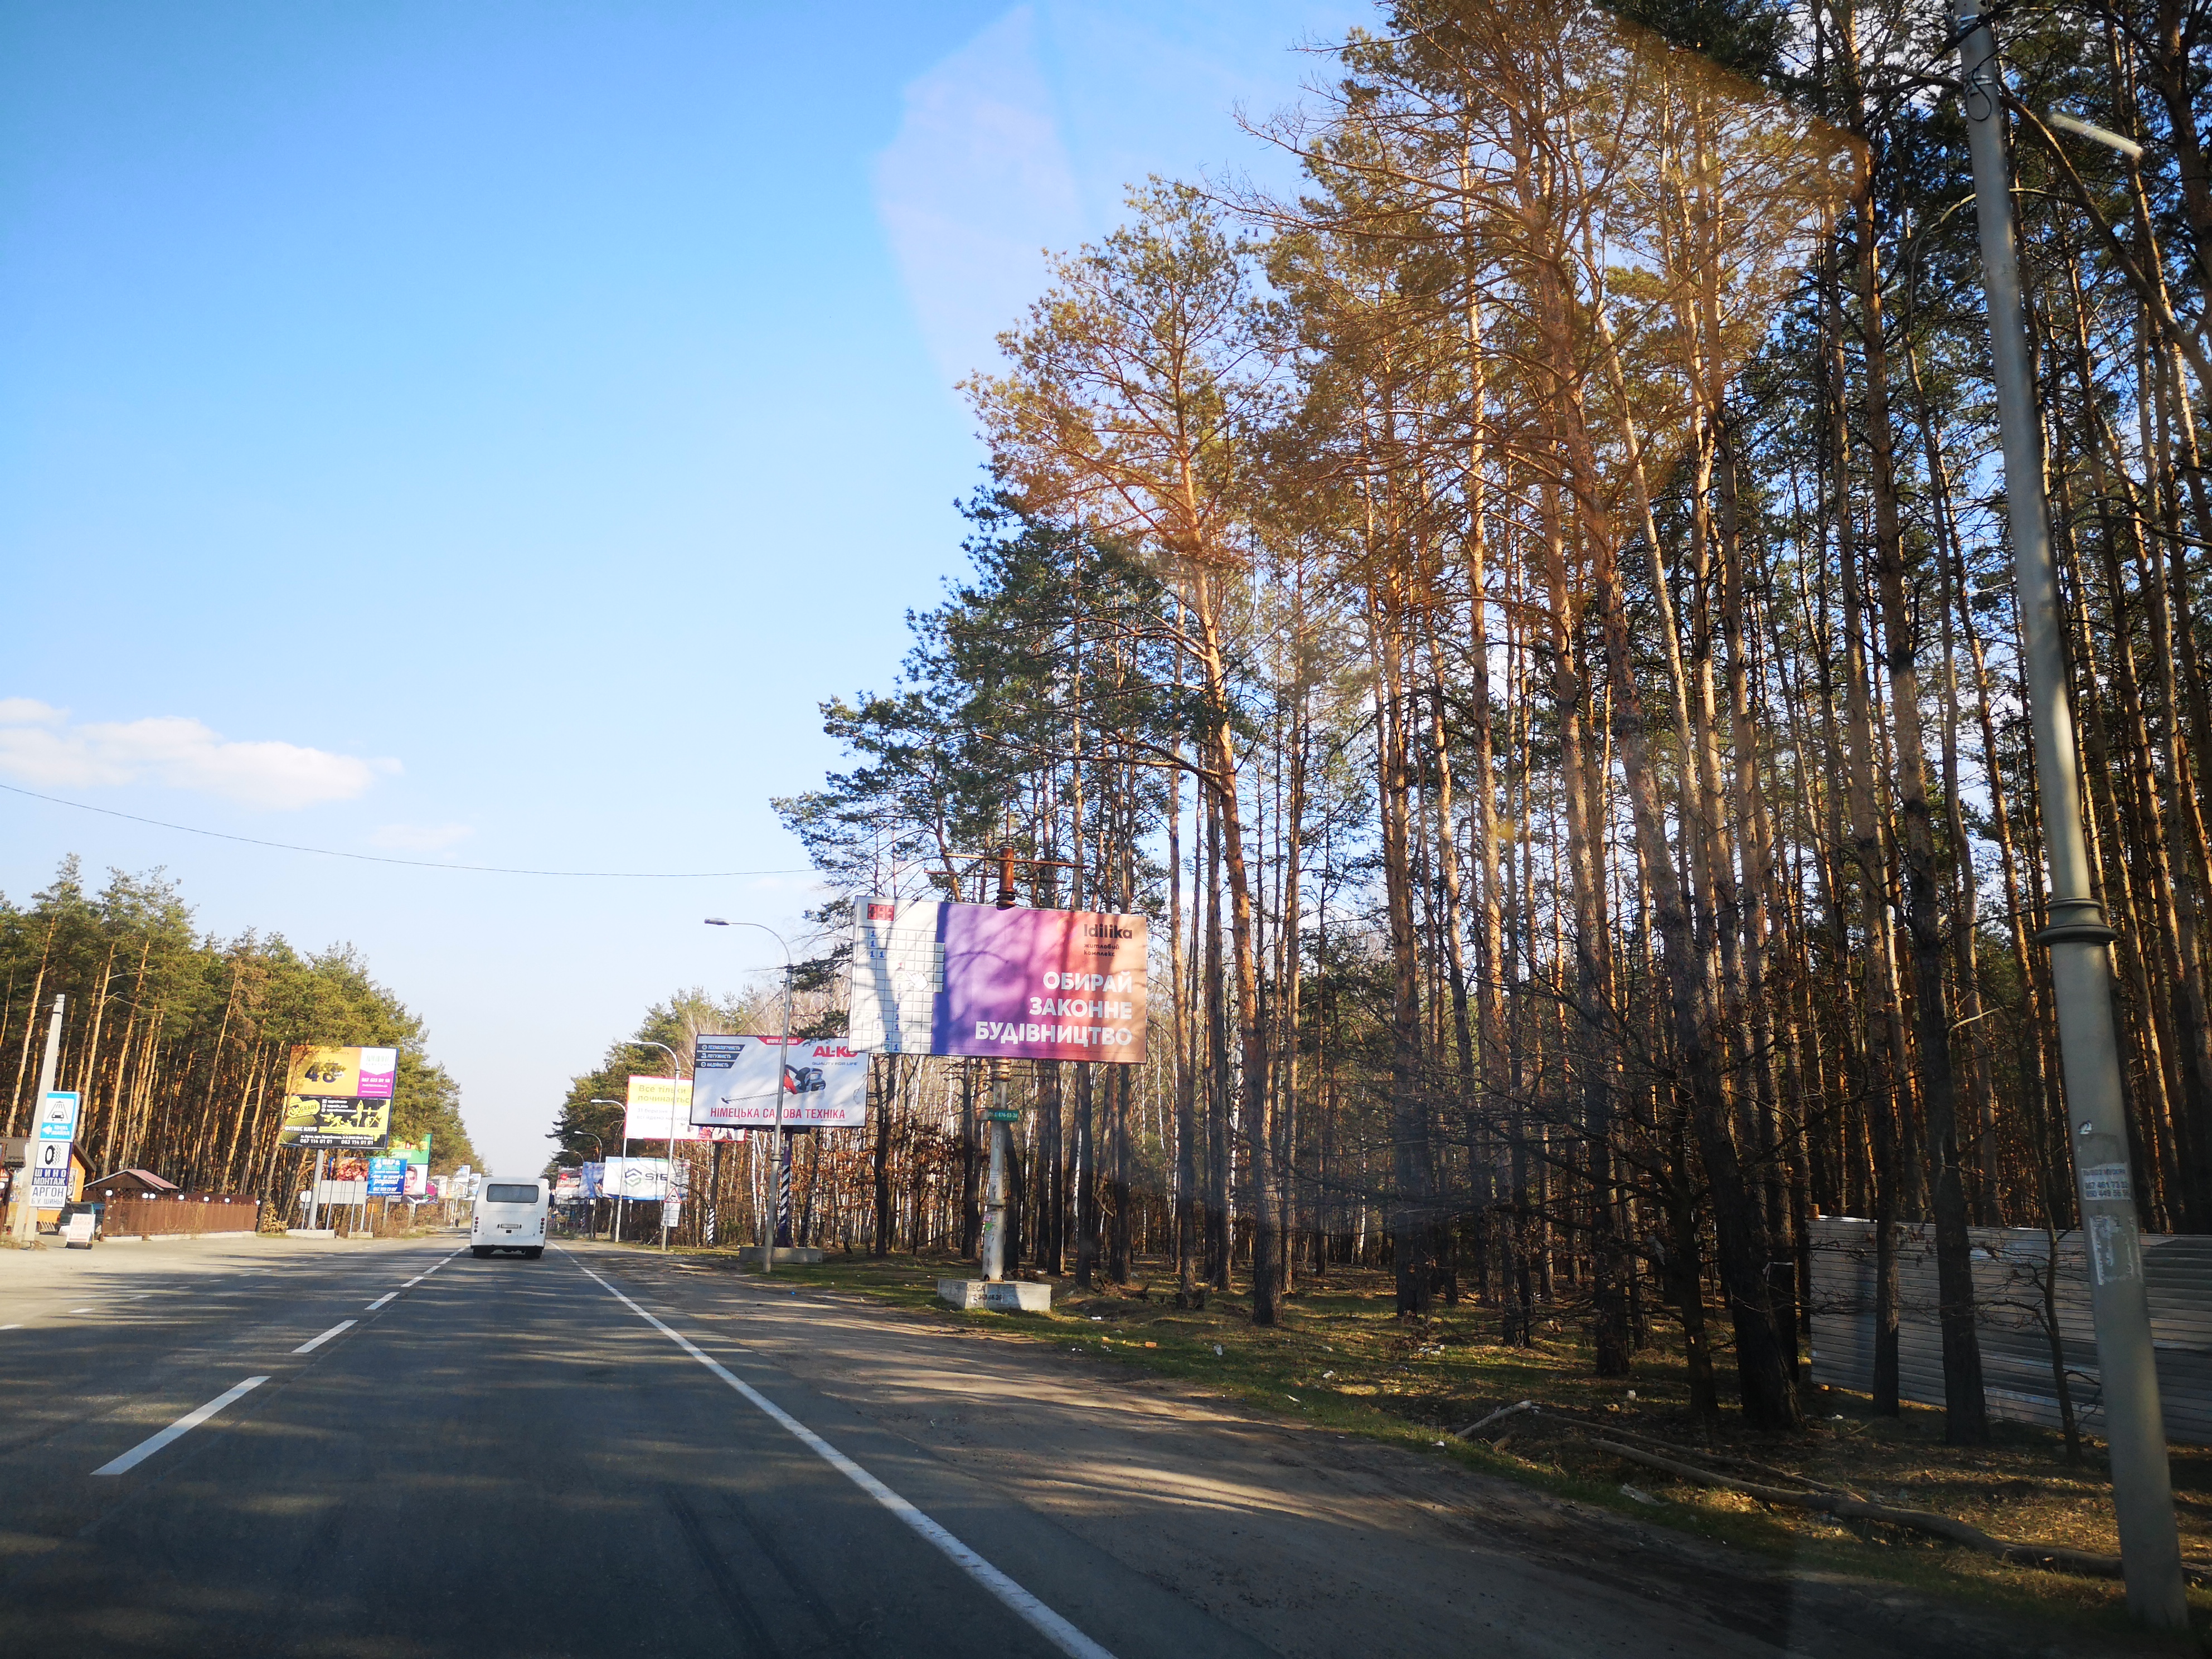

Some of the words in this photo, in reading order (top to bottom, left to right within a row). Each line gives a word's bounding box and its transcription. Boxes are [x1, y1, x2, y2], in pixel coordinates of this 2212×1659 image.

[1084, 924, 1133, 939] Idilika
[1043, 971, 1132, 993] ОБИРАЙ
[1029, 997, 1132, 1020] ЗАКОННЕ
[976, 1021, 1132, 1047] БУДІВНИЦТВО
[710, 1107, 759, 1119] НІМЕЦЬКА
[763, 1108, 802, 1119] САОВА
[805, 1109, 845, 1119] ТЕХНІКА
[33, 1177, 65, 1185] МОНТАЖ
[32, 1187, 64, 1197] АРГОН
